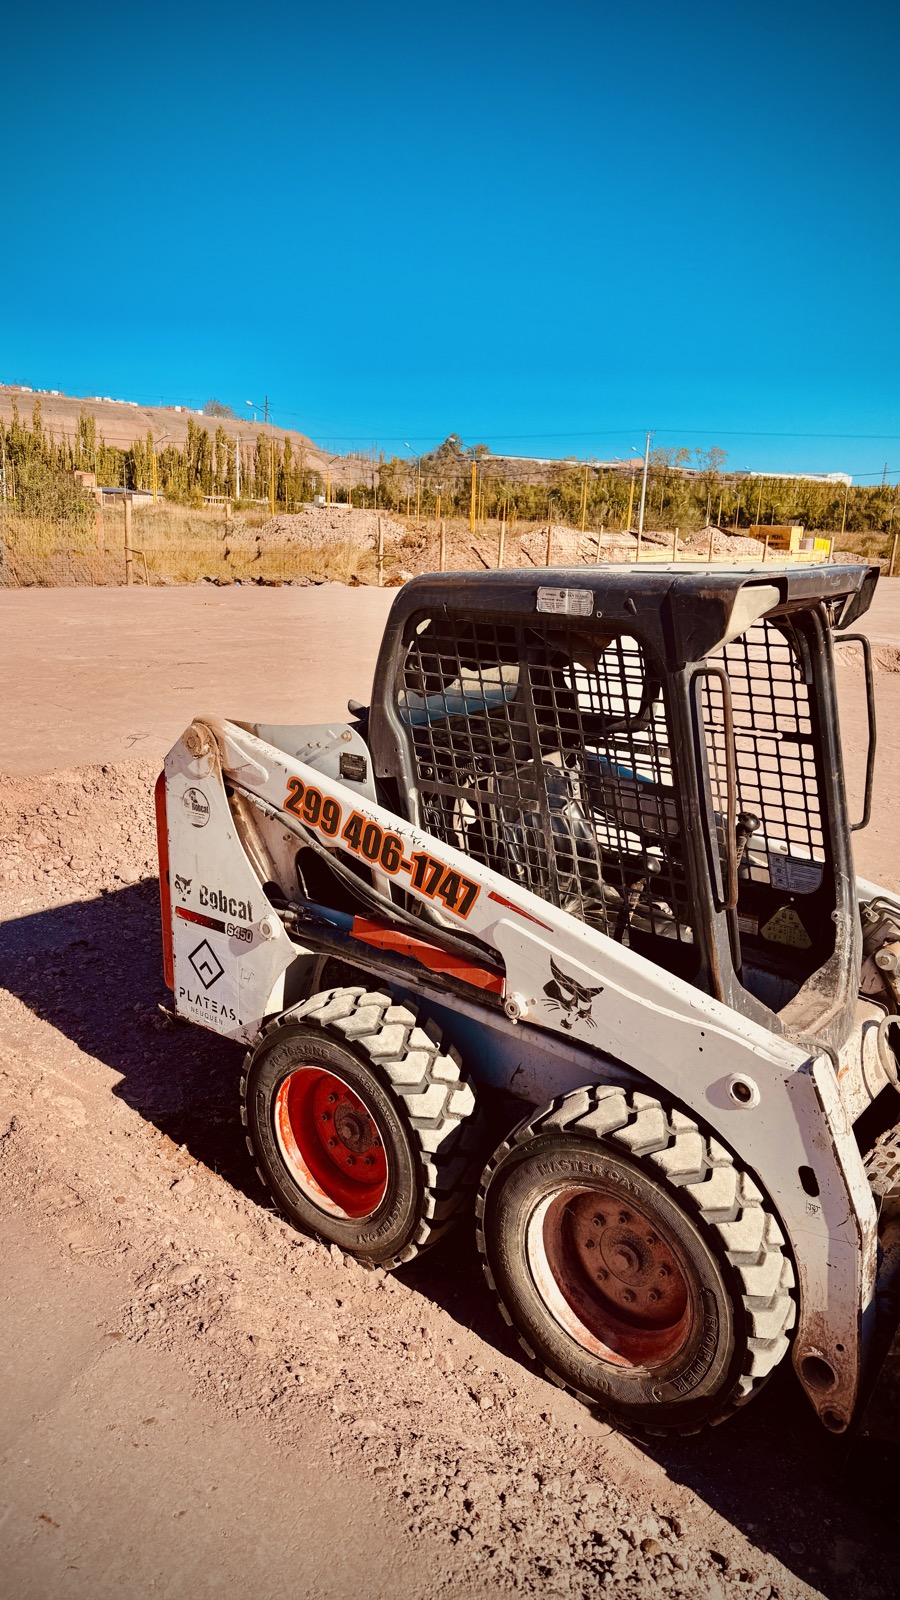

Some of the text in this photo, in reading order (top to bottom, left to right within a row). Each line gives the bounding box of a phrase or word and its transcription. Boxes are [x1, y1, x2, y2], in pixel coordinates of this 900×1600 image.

[284, 776, 481, 920] 299 406-1747
[199, 885, 254, 922] Bobcat
[226, 922, 254, 944] S450
[537, 1159, 643, 1196] MASTER CAT
